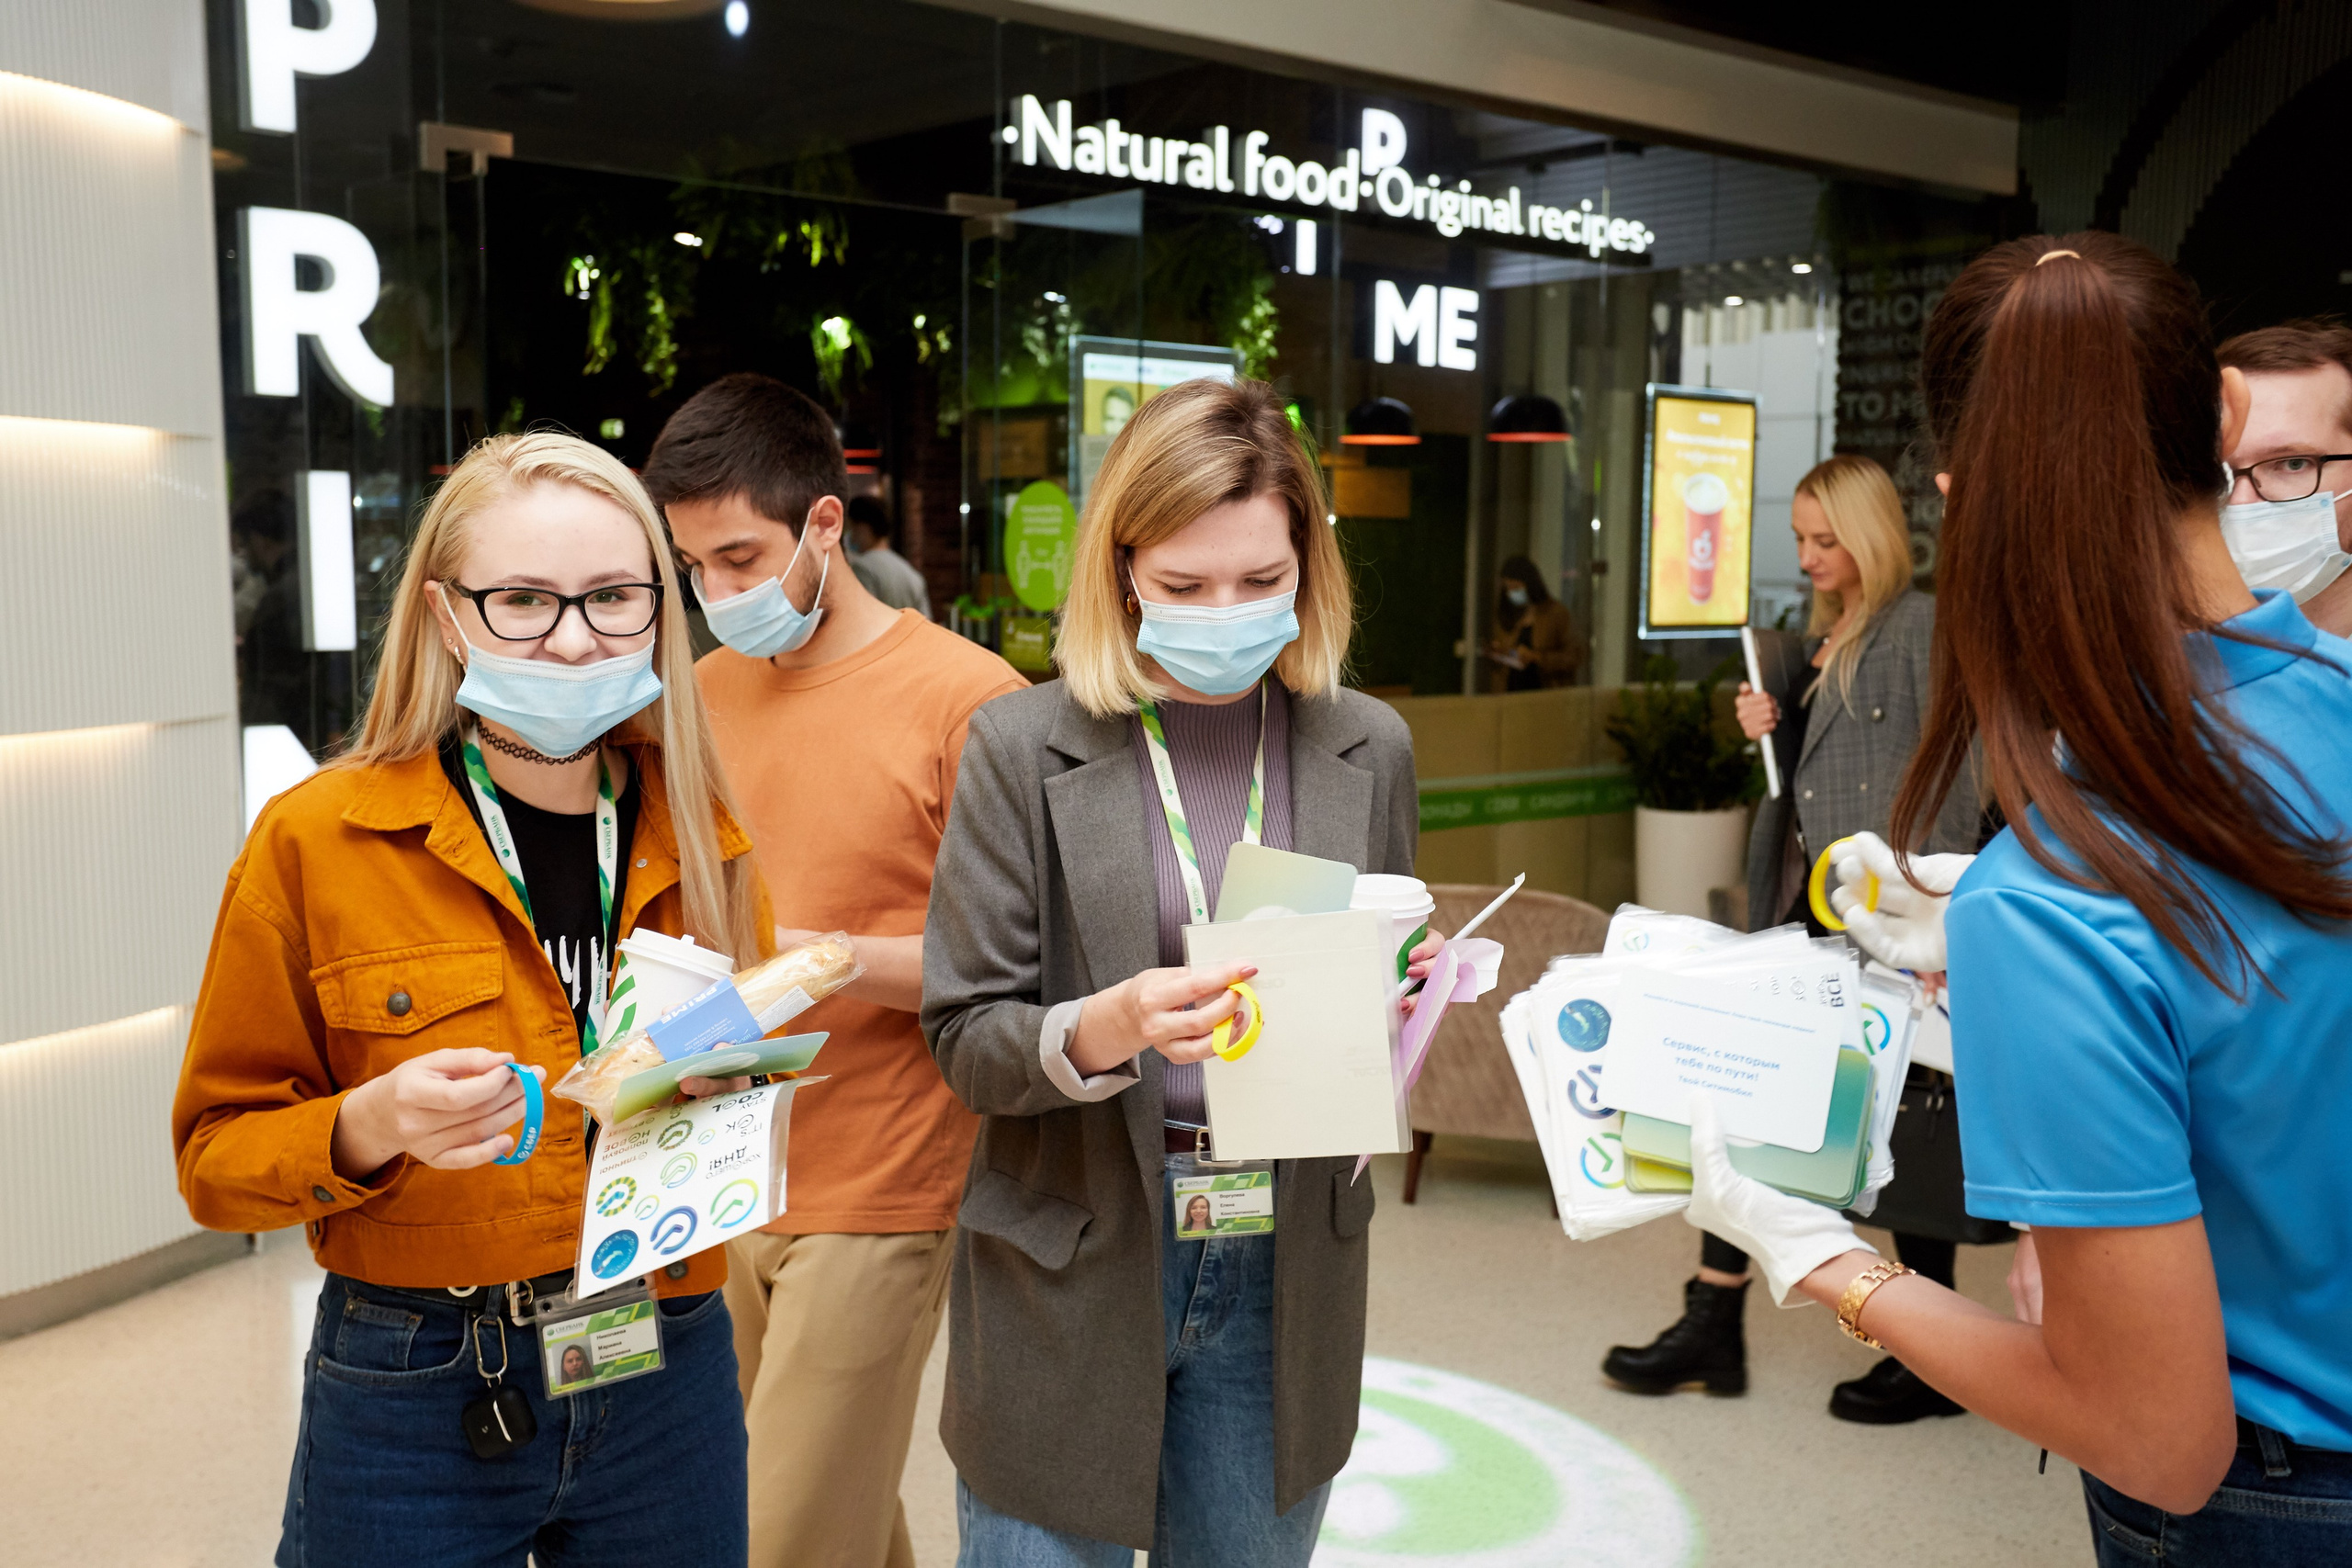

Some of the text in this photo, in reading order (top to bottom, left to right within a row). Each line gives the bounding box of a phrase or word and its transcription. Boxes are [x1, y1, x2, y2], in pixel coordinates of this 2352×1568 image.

[1021, 93, 1646, 258] Natural food Original recipes
[660, 983, 718, 1025] PRIME
[1663, 1035, 1712, 1059] Сервис,
[1724, 1049, 1781, 1072] которым
[1675, 1054, 1760, 1083] тебе по пути!
